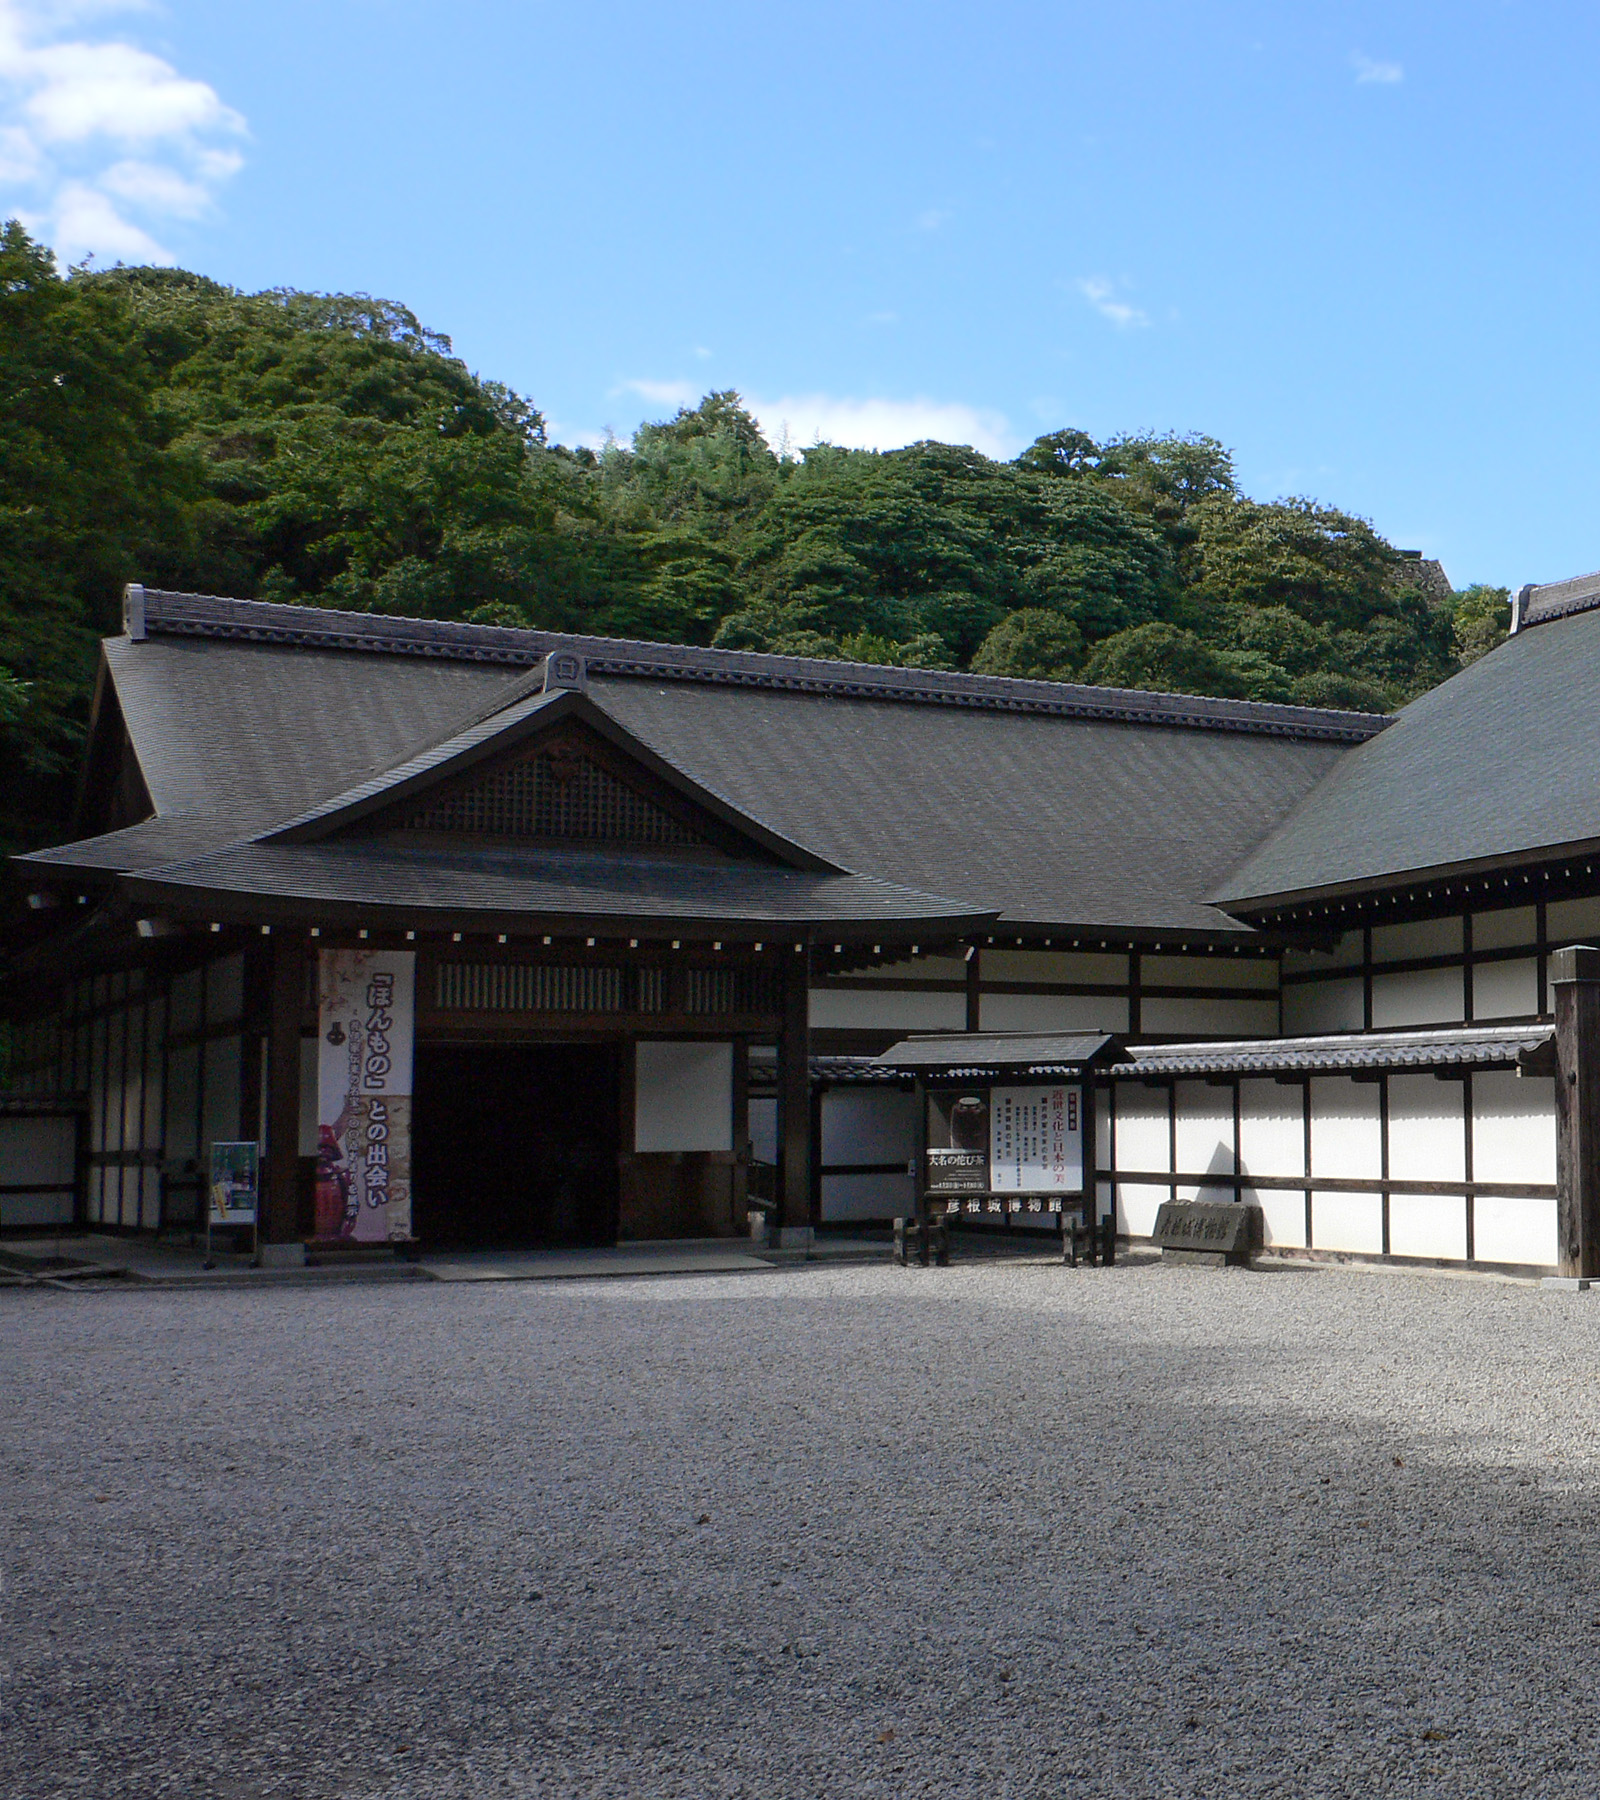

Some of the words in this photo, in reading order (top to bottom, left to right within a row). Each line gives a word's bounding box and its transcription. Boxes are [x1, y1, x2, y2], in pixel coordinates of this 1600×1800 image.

[364, 972, 394, 1208] 「ほんもの」との出会い
[1052, 1089, 1065, 1185] 近世文化と日本の美
[946, 1197, 1063, 1214] 彦根城博物館
